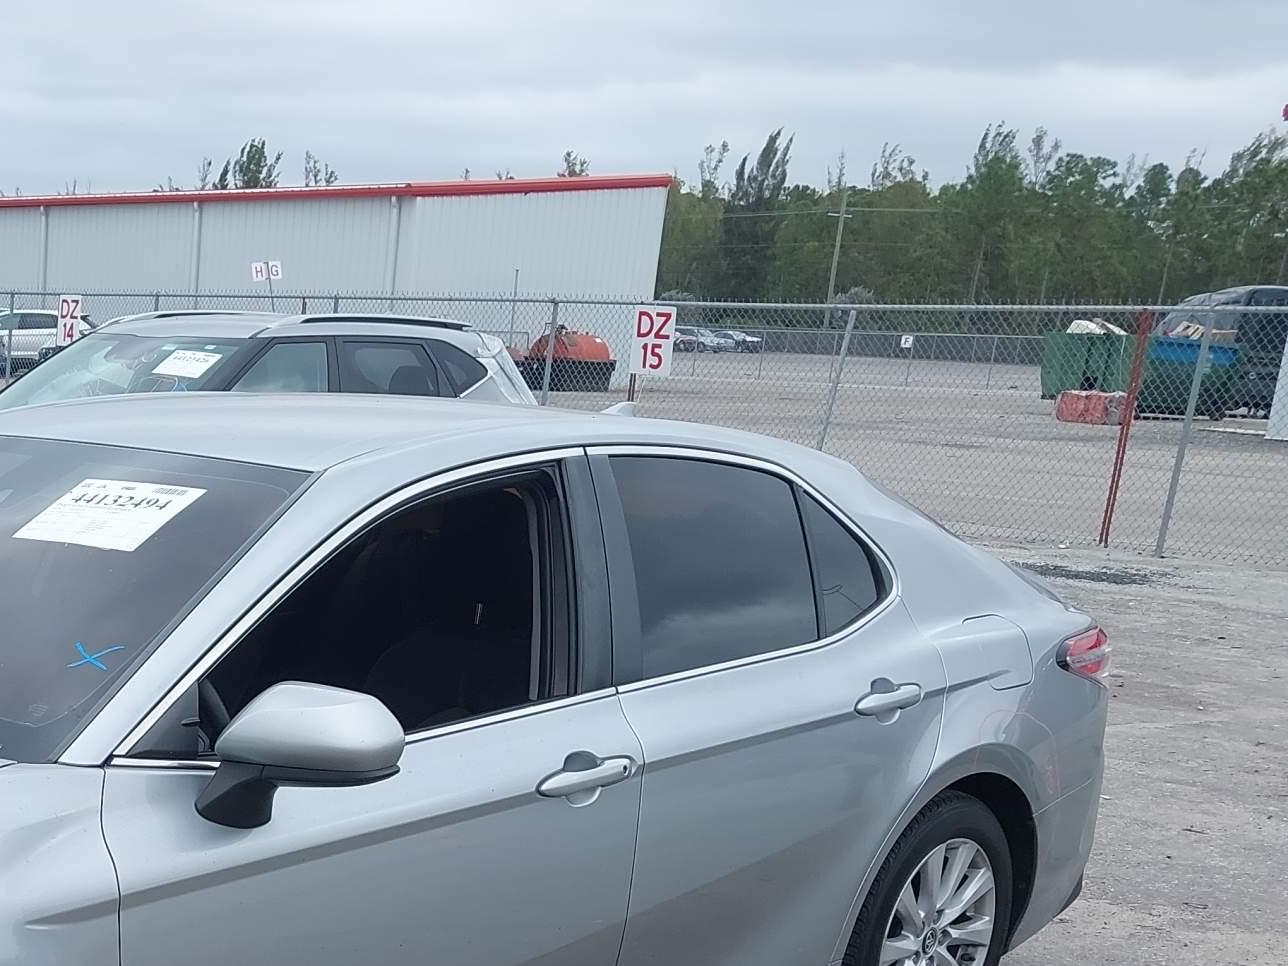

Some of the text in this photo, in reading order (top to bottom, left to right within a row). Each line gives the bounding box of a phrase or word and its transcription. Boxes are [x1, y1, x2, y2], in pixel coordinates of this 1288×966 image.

[255, 265, 264, 278] H
[270, 264, 279, 277] G
[60, 299, 80, 320] DZ
[63, 321, 74, 342] 14
[637, 311, 672, 340] DZ
[642, 342, 663, 370] 15
[71, 492, 173, 511] 44132494
